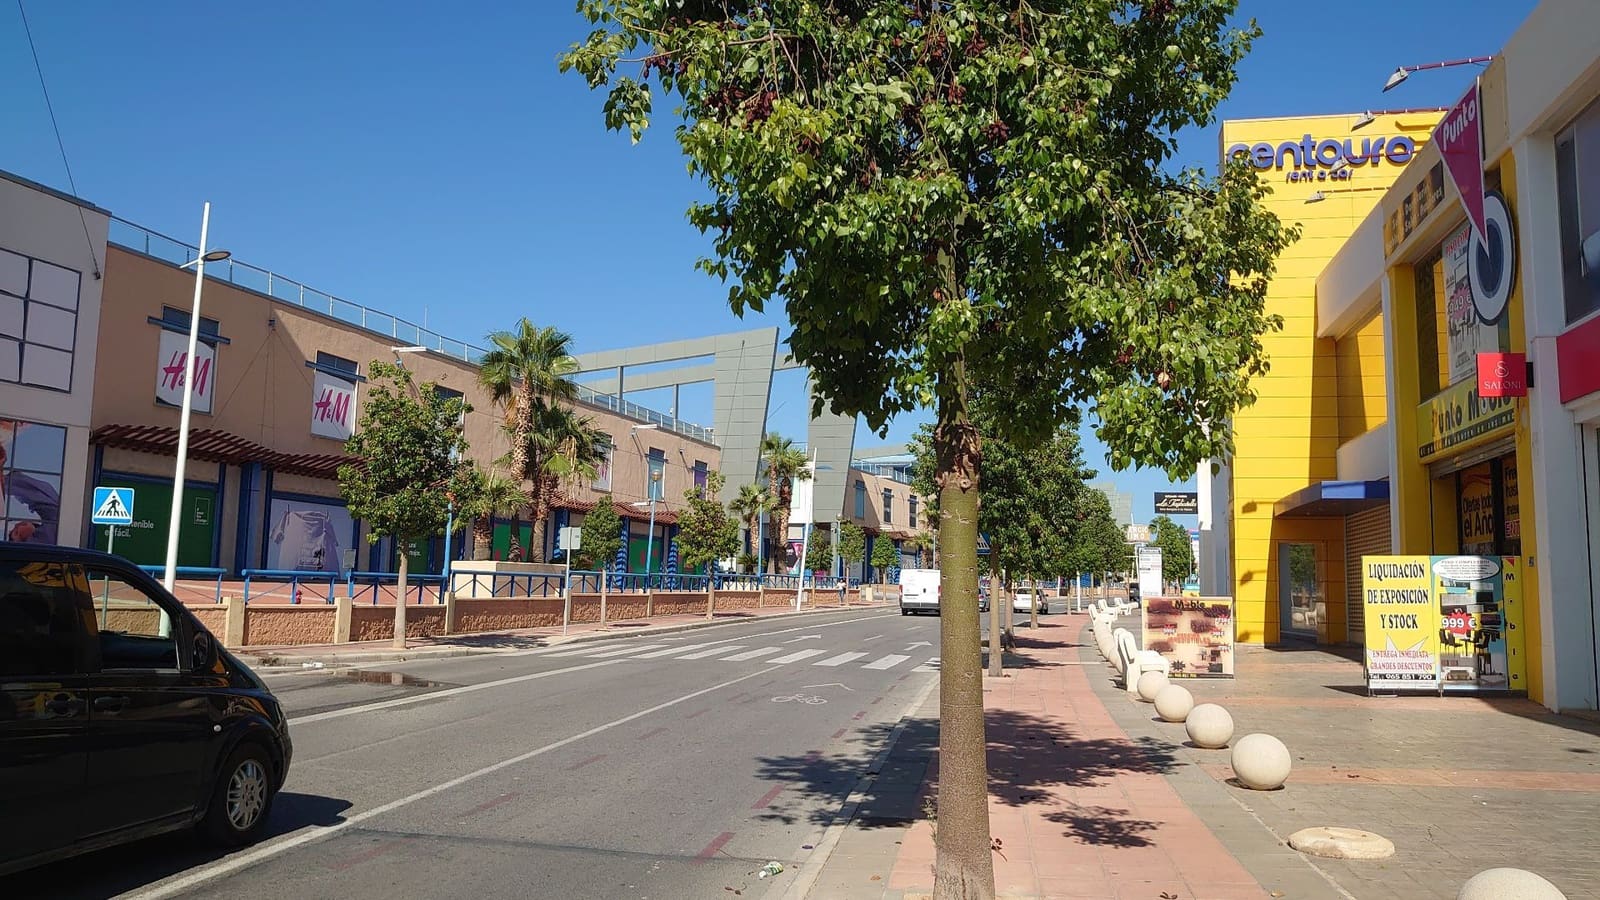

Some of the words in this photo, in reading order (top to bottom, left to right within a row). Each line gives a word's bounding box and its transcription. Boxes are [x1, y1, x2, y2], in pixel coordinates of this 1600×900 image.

[1443, 99, 1476, 152] Punto
[163, 350, 211, 397] H&M
[1484, 380, 1520, 390] SALONI
[314, 387, 350, 427] H&M
[1464, 512, 1472, 537] el
[1368, 560, 1425, 581] LIQUIDACIÓN
[1367, 589, 1378, 604] DE
[1380, 586, 1429, 604] EXPOSICIÓN
[1380, 614, 1387, 629] Y
[1388, 614, 1418, 629] STOCK
[1442, 618, 1465, 628] 999
[1468, 618, 1476, 628] €
[1373, 650, 1397, 658] ENTREGA
[1399, 650, 1429, 658] INMEDIATA
[1370, 662, 1396, 671] GRANDES
[1397, 662, 1432, 671] DESCUENTOS
